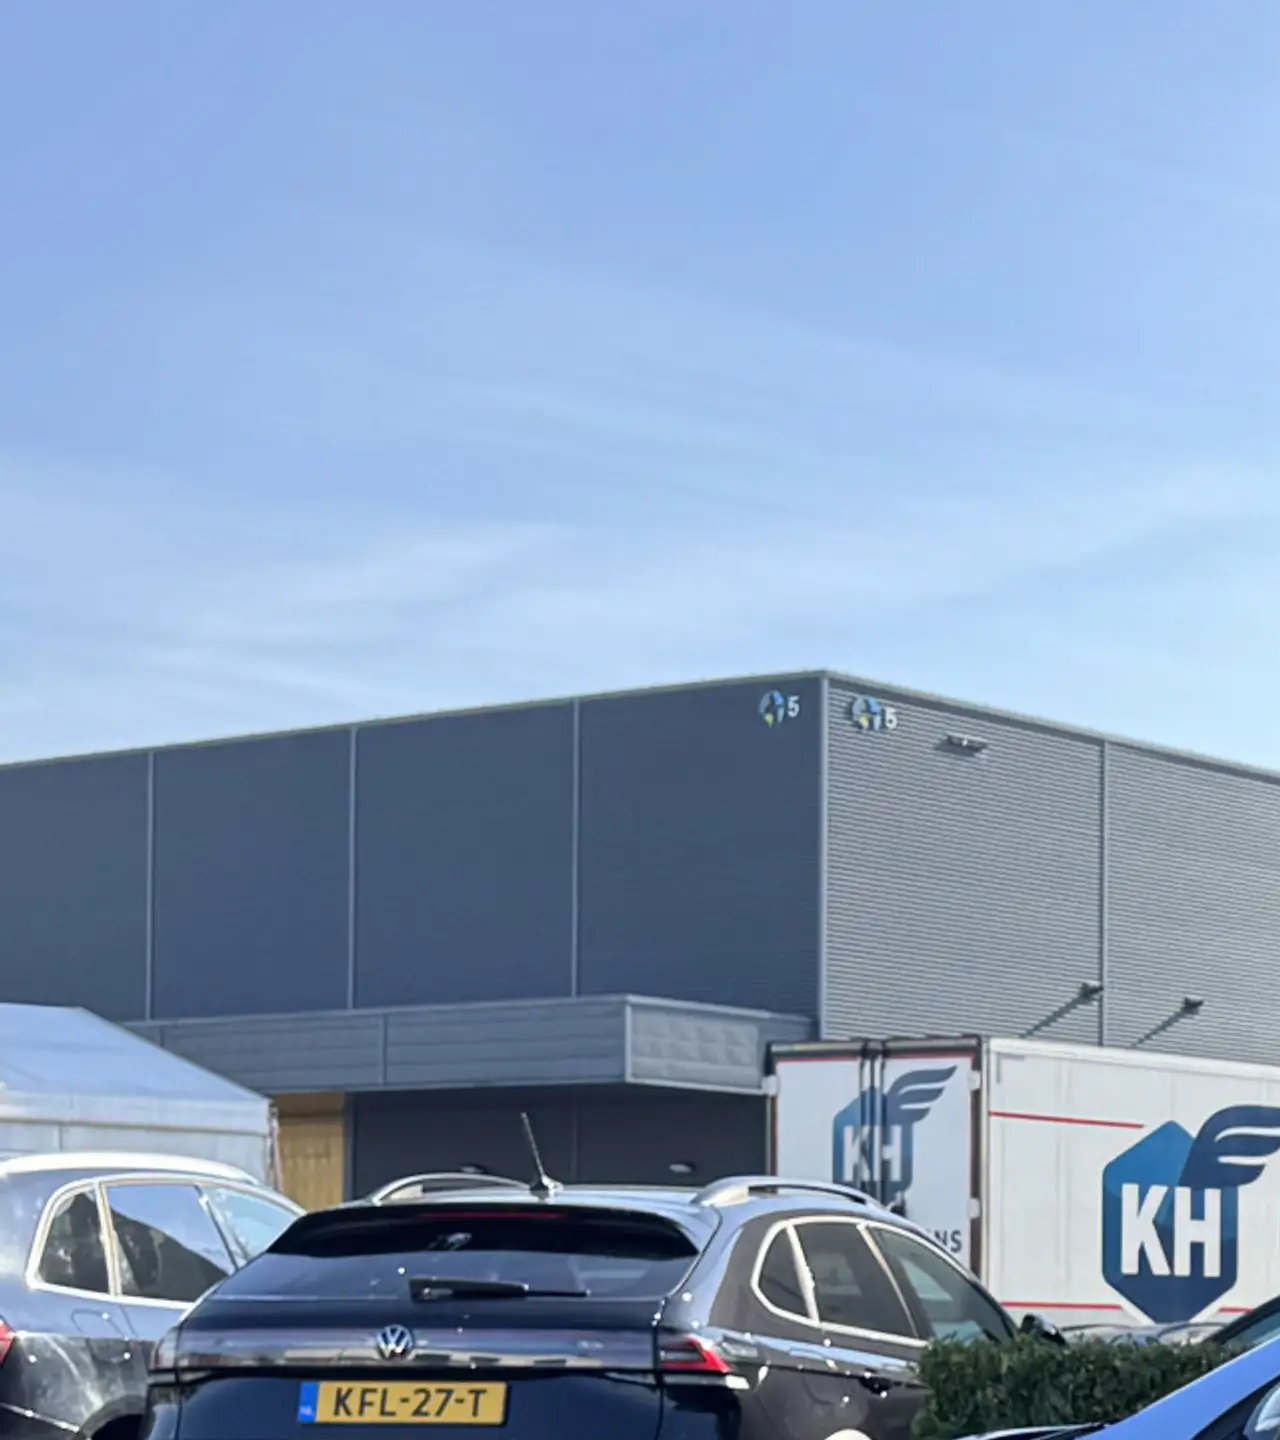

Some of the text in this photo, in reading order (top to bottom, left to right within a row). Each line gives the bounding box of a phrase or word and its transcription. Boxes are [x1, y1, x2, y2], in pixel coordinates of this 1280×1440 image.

[787, 696, 800, 718] 5
[884, 708, 898, 730] 5
[1120, 1183, 1222, 1278] KH
[333, 1386, 488, 1418] KFL-27-T
